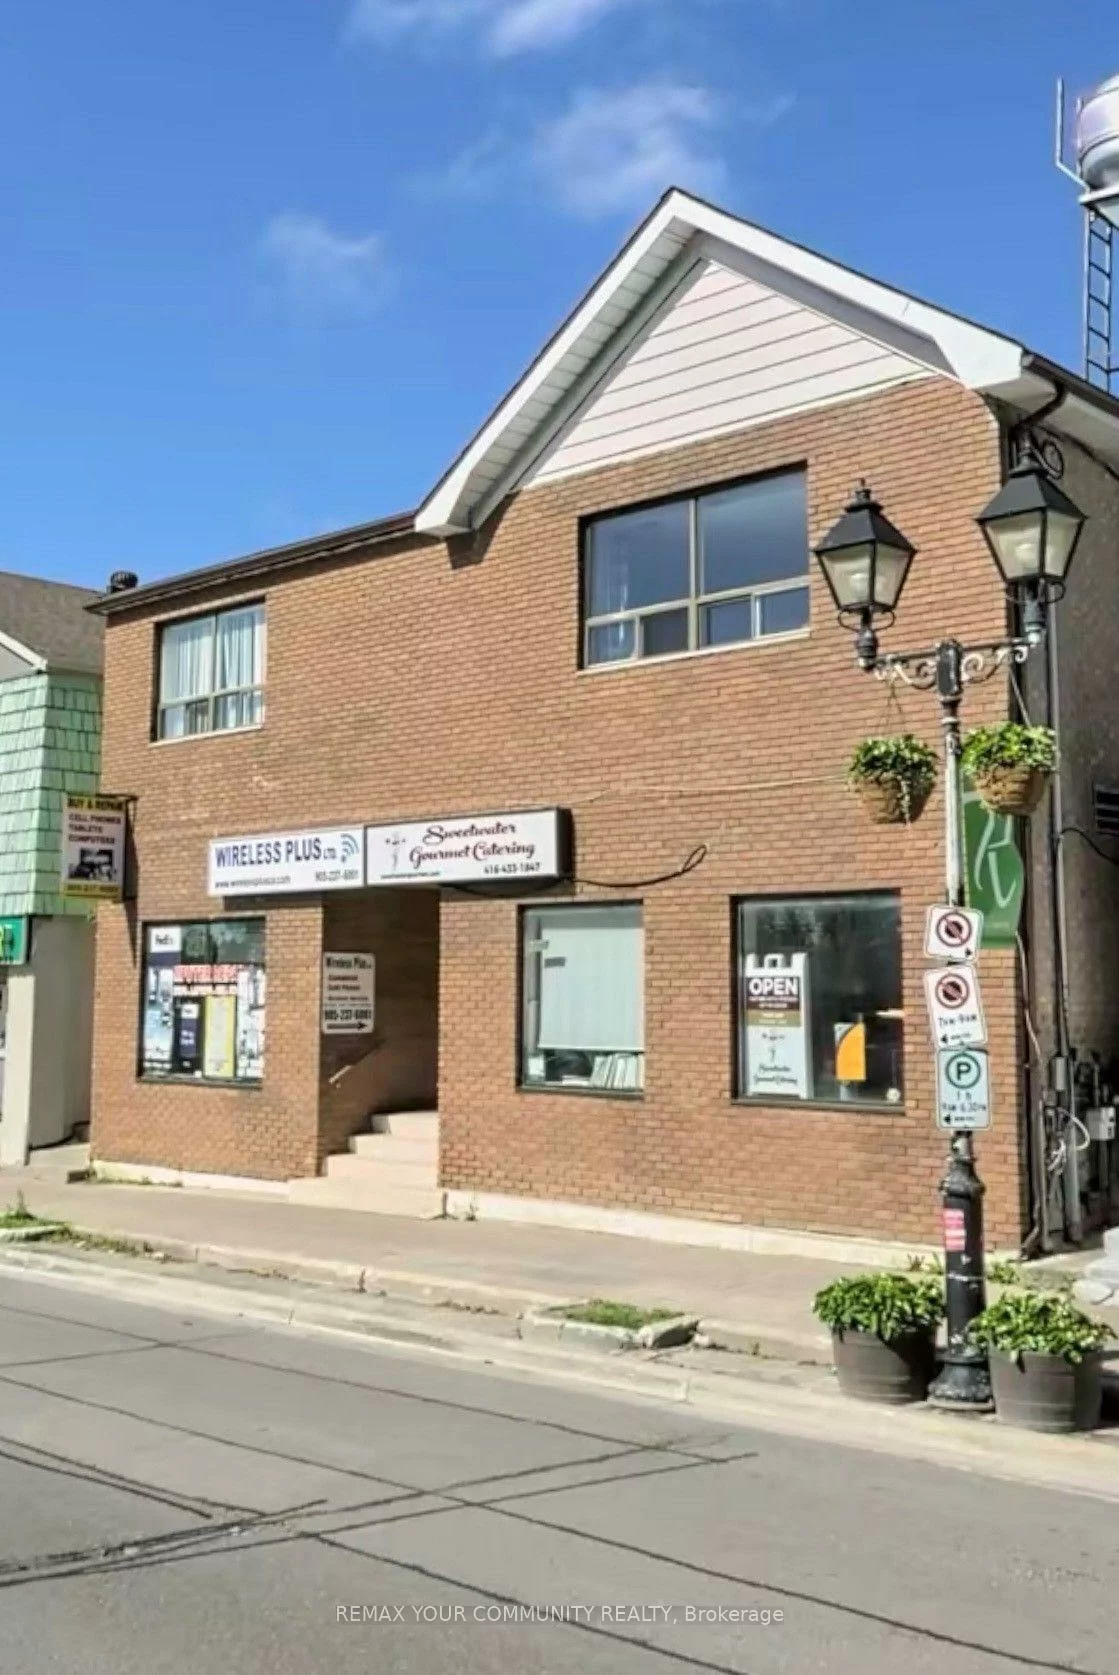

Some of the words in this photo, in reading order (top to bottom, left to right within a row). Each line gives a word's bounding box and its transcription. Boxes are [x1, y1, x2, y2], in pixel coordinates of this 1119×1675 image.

[422, 822, 517, 846] Sweetwater
[214, 841, 282, 868] WIRELESS
[286, 837, 322, 863] PLUS
[409, 845, 470, 869] Gourmet
[473, 841, 535, 861] Catering
[749, 978, 798, 995] OPEN
[956, 1061, 971, 1081] P
